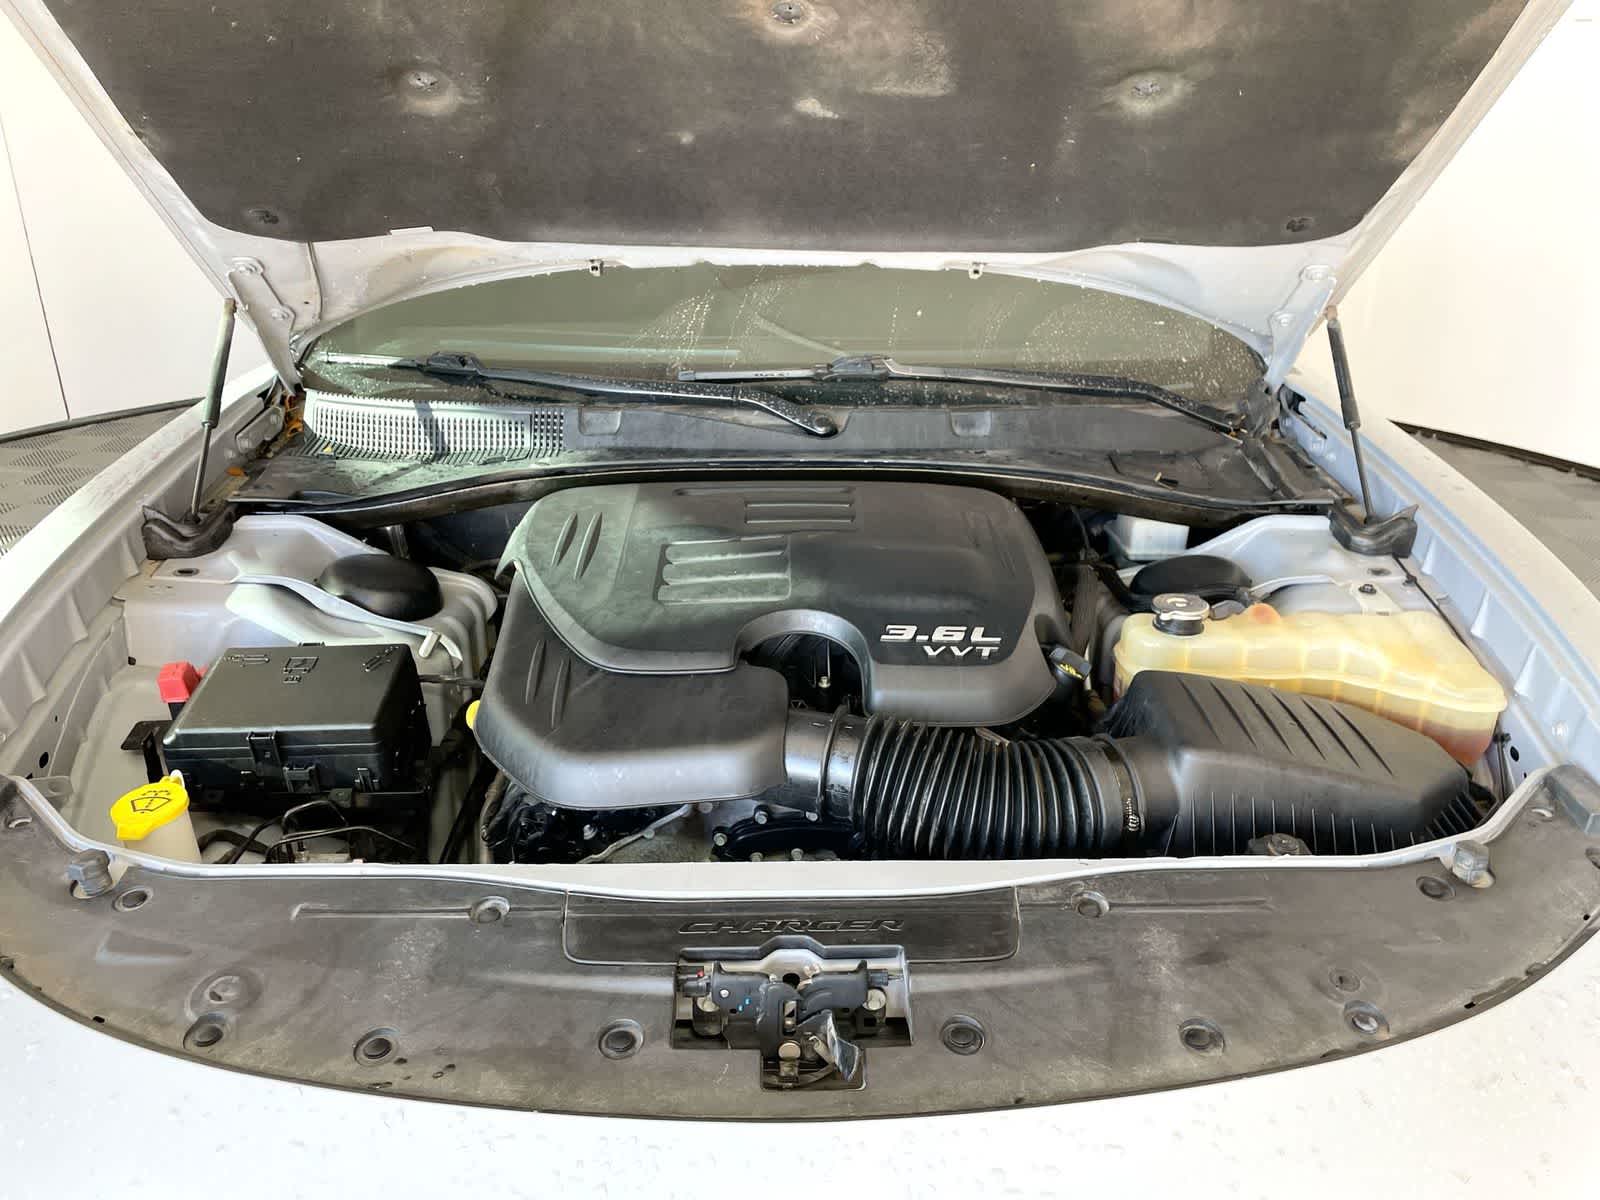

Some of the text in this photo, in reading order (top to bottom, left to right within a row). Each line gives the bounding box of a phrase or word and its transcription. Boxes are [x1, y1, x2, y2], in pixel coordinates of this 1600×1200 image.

[880, 625, 1002, 642] 3.6L
[922, 645, 999, 659] VVT
[678, 919, 905, 934] CHARGER
